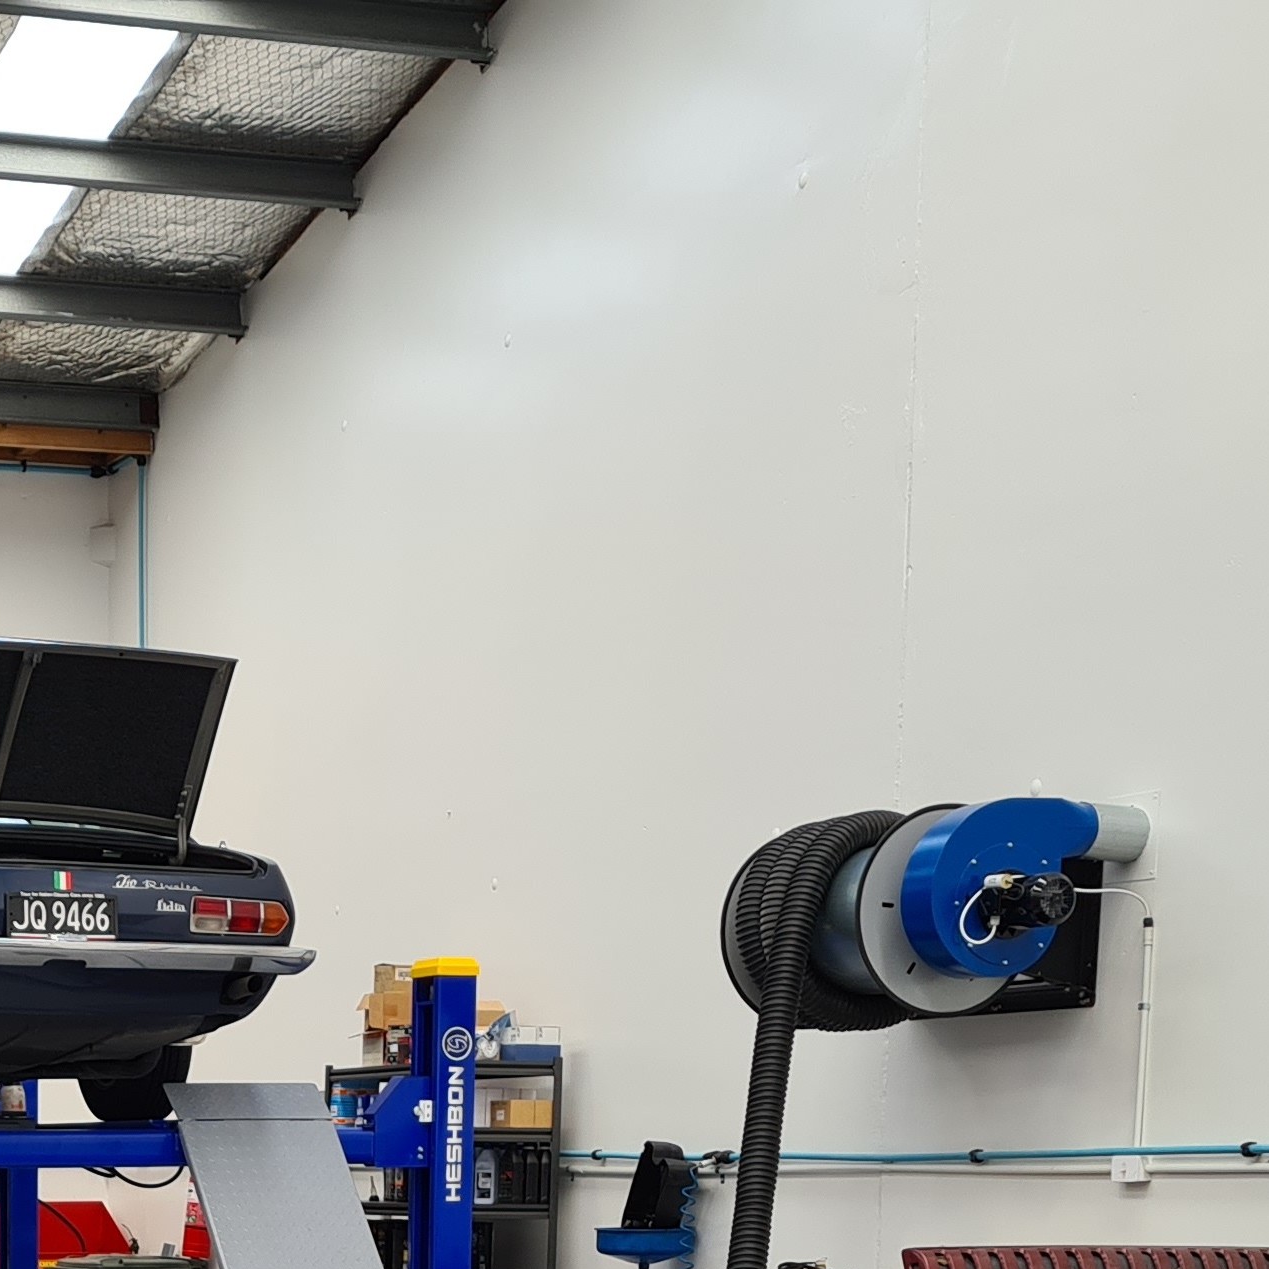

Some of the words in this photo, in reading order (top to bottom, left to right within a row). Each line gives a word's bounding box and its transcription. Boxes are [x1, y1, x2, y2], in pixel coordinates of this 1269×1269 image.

[12, 900, 46, 931] JQ
[52, 901, 110, 932] 9466
[446, 1066, 464, 1202] HESHBON
